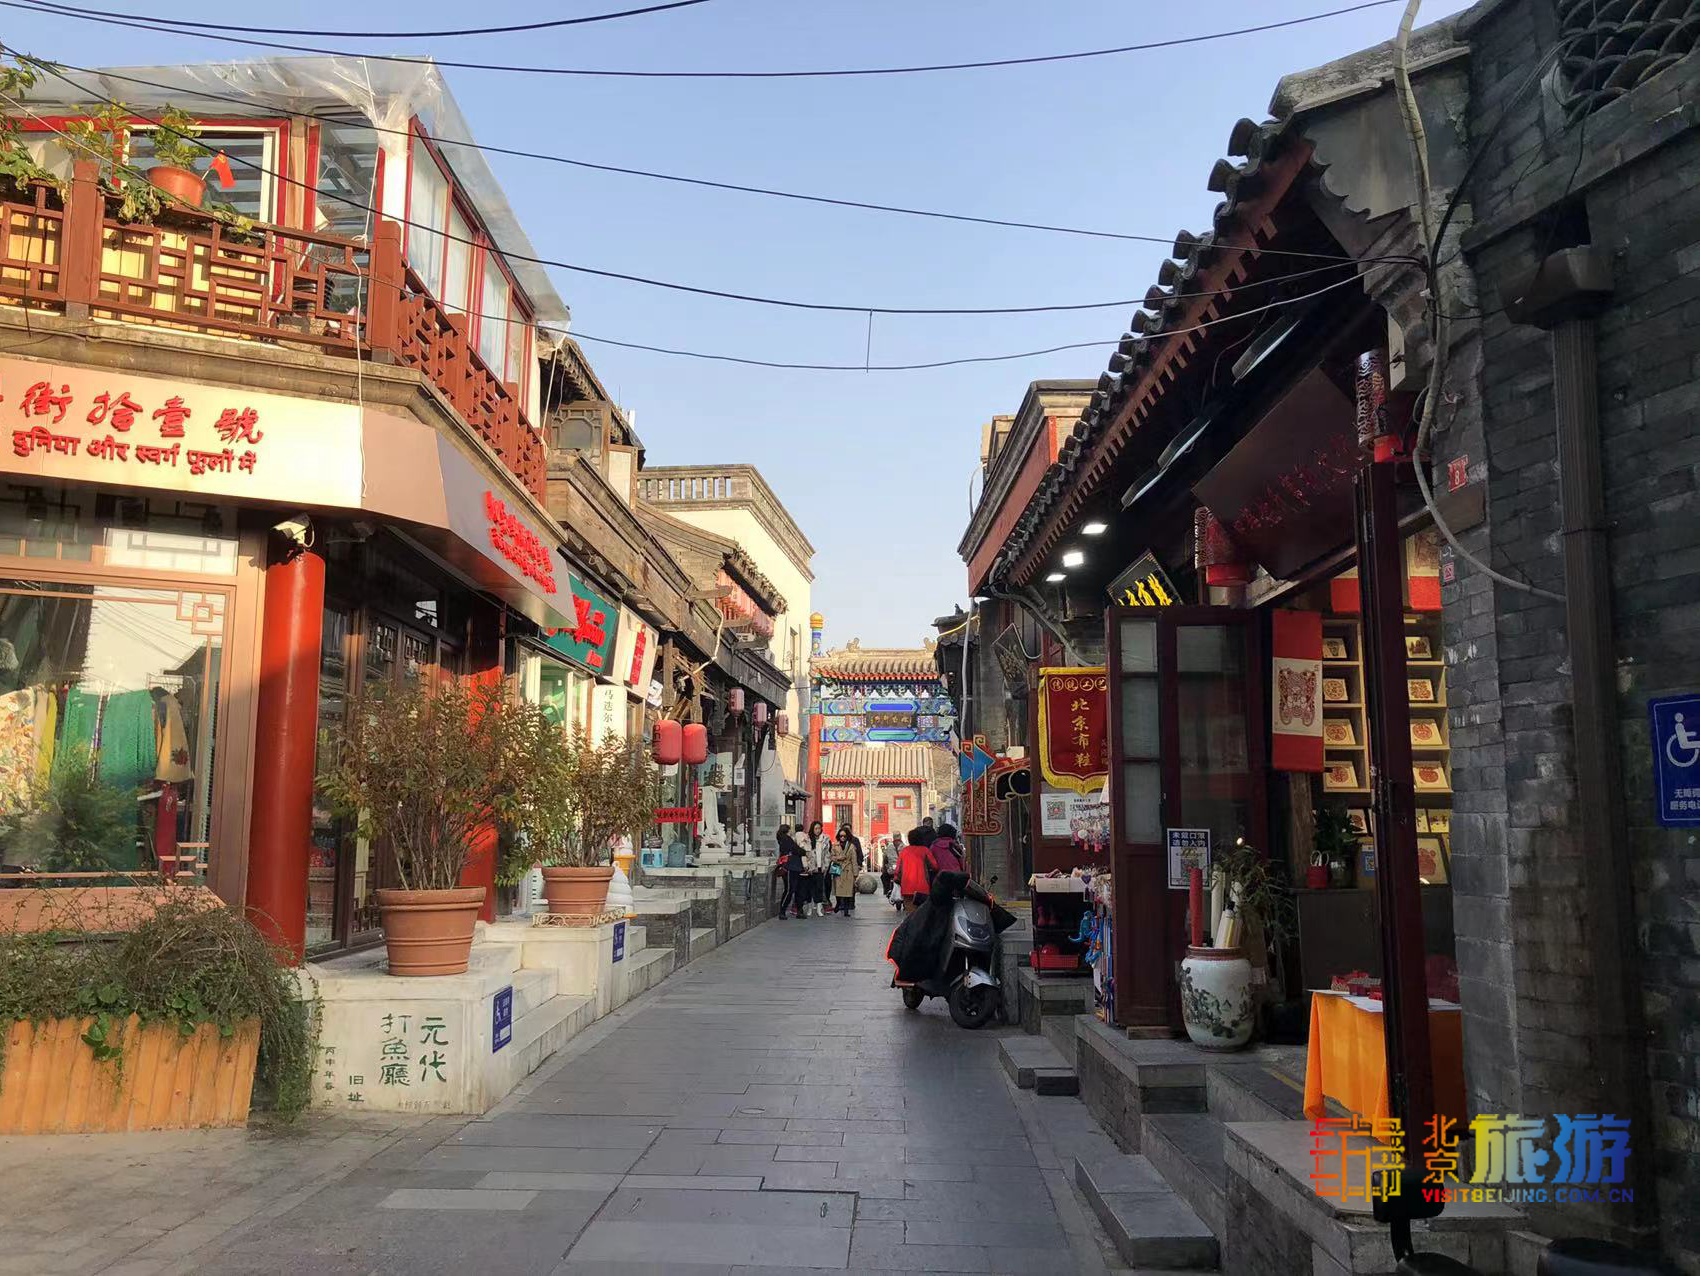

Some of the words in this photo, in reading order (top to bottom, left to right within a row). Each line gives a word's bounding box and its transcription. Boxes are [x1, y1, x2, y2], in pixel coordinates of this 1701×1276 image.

[0, 381, 264, 445] 街拾壹號
[86, 434, 130, 462] और
[135, 442, 181, 467] स्वर्ग
[238, 449, 257, 474] में
[1455, 470, 1460, 485] 8
[1070, 698, 1093, 767] 北京布鞋
[419, 1016, 449, 1082] 元代
[347, 1075, 365, 1102] 旧址
